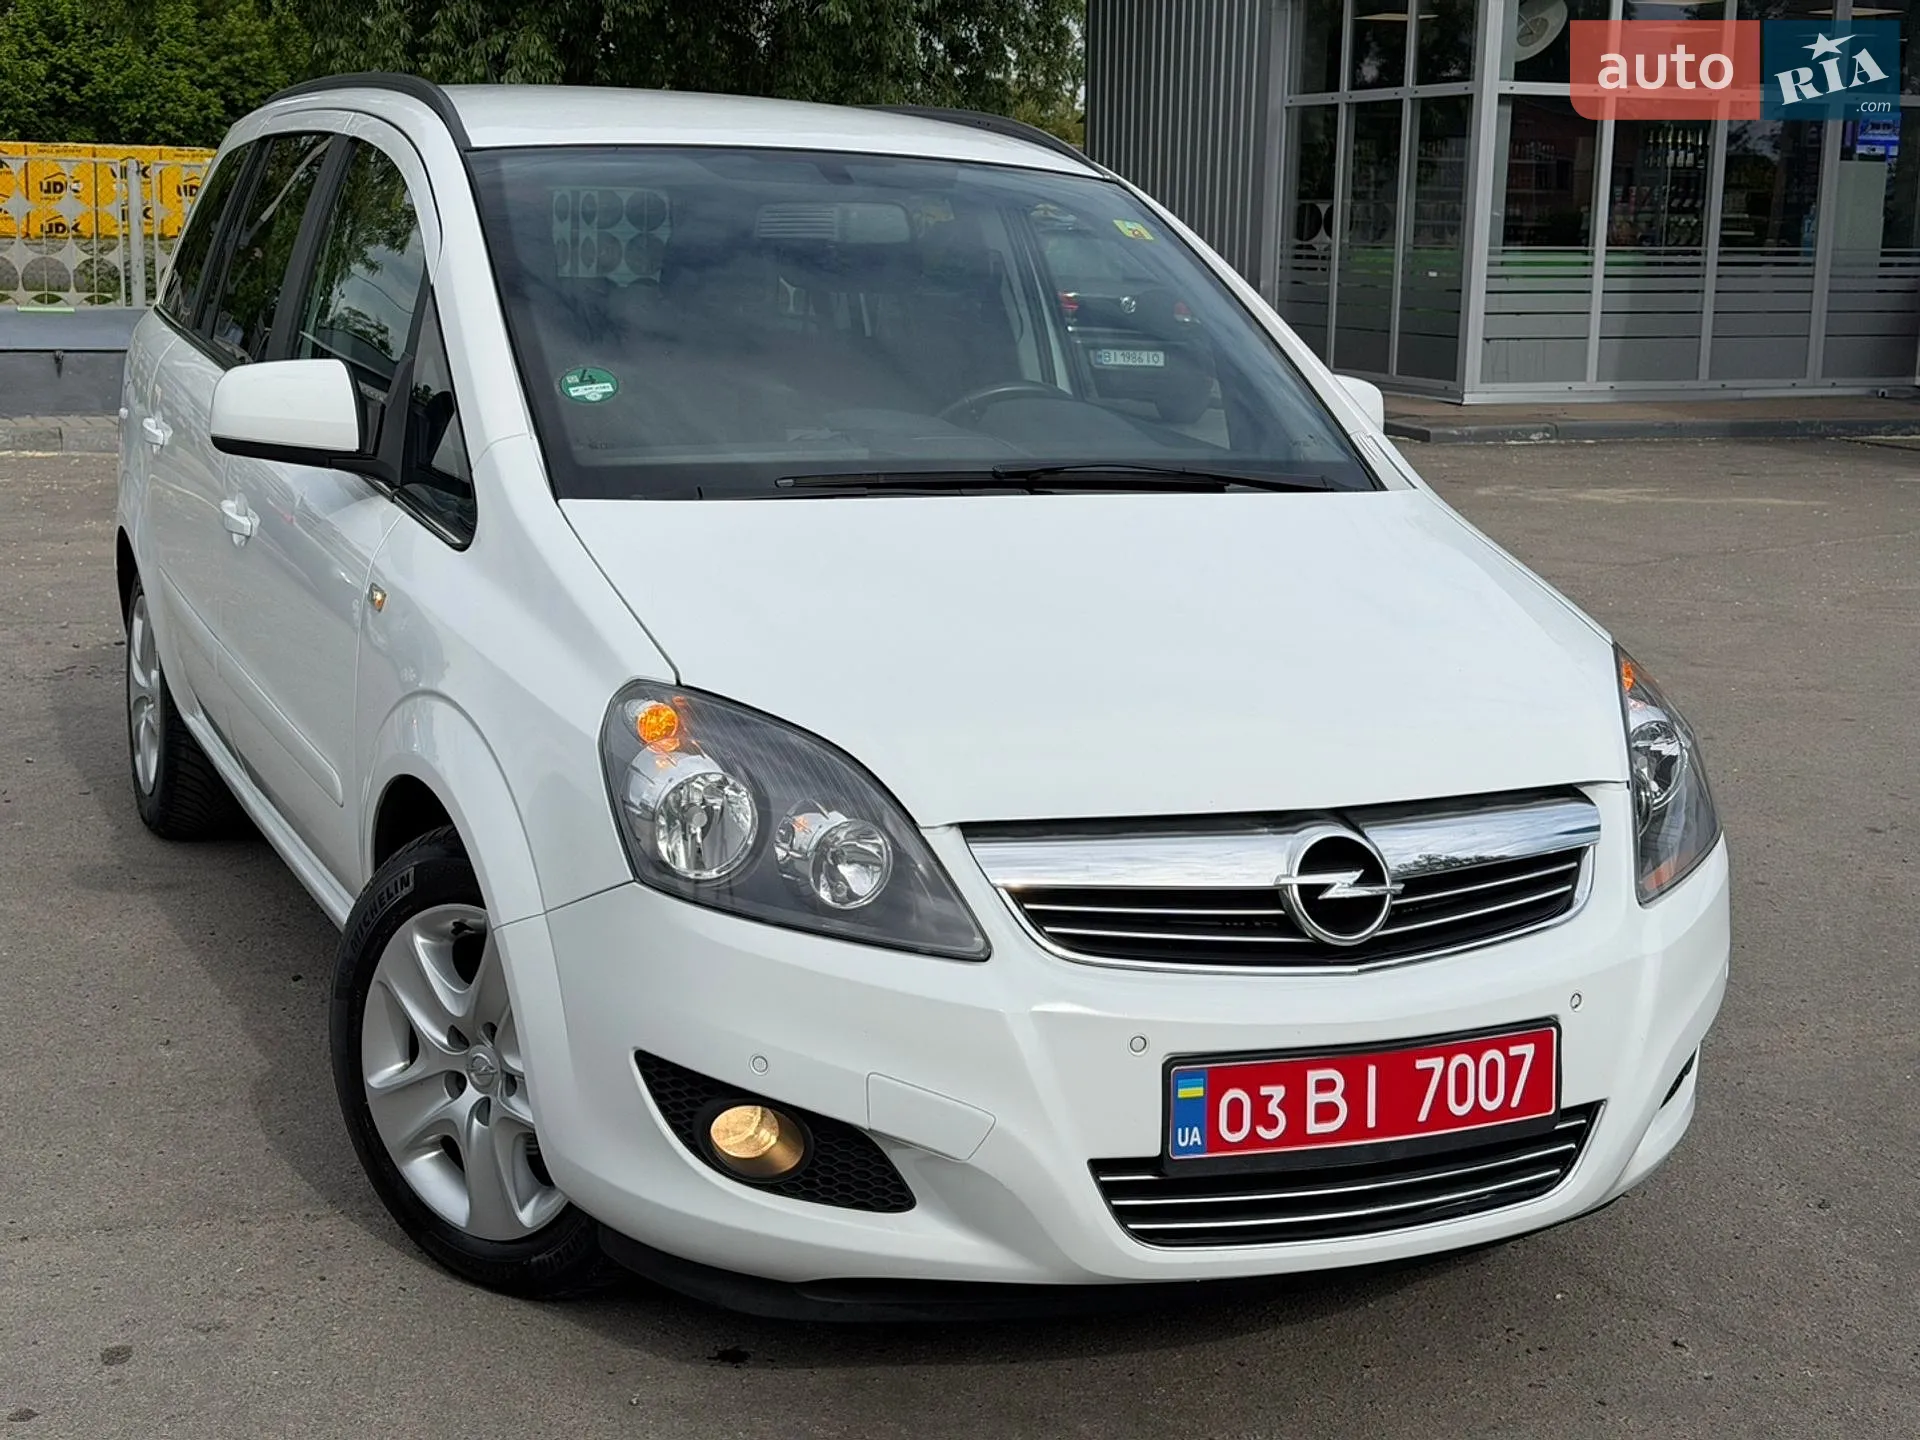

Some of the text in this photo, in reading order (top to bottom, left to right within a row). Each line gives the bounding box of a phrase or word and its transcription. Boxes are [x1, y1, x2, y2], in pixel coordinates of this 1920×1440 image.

[350, 872, 410, 953] MICHELIN
[1219, 1043, 1535, 1143] 03 BI 7007
[1178, 1126, 1201, 1148] UA
